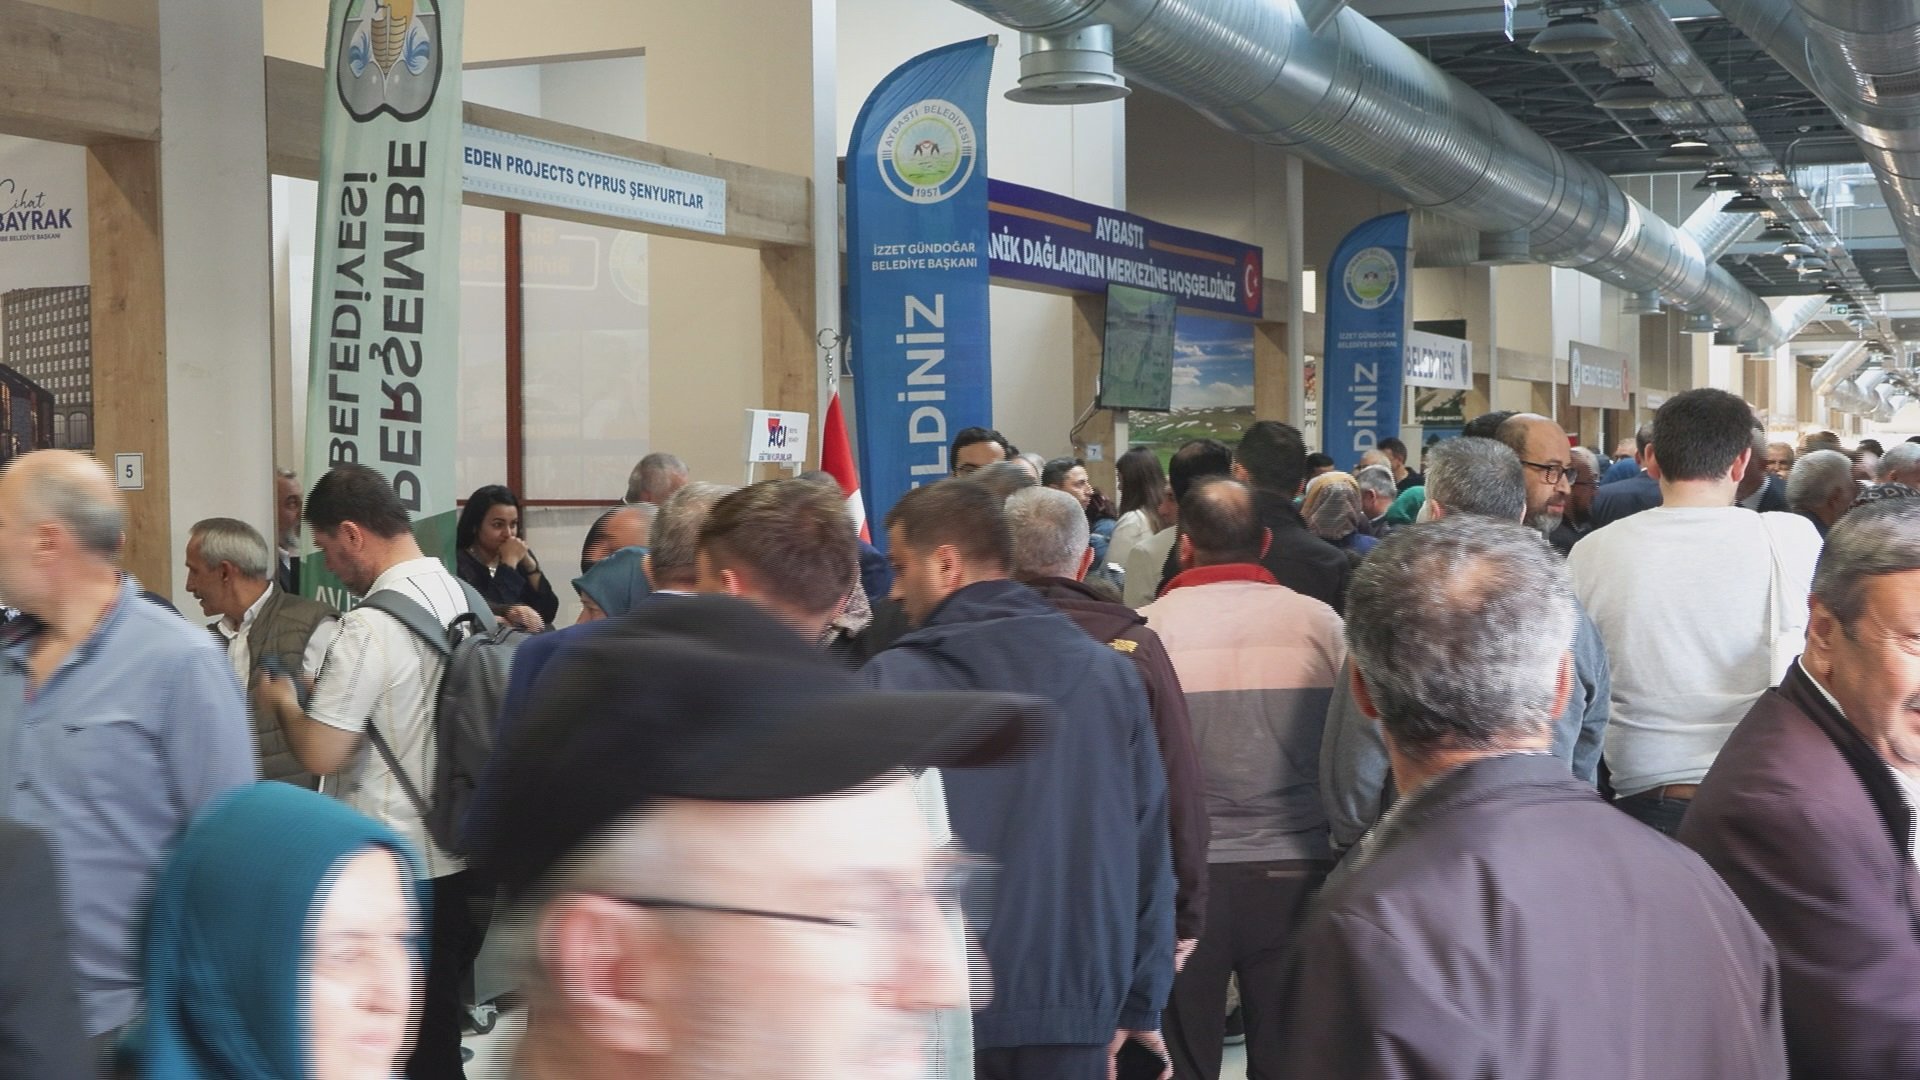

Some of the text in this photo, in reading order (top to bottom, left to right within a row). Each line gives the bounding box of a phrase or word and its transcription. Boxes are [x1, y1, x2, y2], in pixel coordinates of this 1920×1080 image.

[464, 146, 704, 210] EDEN PROJECTS CYPRUS ŞENYURTLAR
[915, 187, 938, 198] 1957
[1096, 215, 1144, 250] AYBASTI
[873, 240, 976, 256] İZZET GÜNDOĞAR
[872, 257, 978, 271] BELEDİYE BAŞKANI
[1023, 236, 1106, 279] DAĞLARININ
[1107, 256, 1168, 290] MERKEZİNE
[1169, 269, 1236, 303] HOŞGELDİNİZ
[896, 293, 948, 490] LDİNİZ
[1091, 448, 1097, 456] 7
[126, 464, 133, 478] 5
